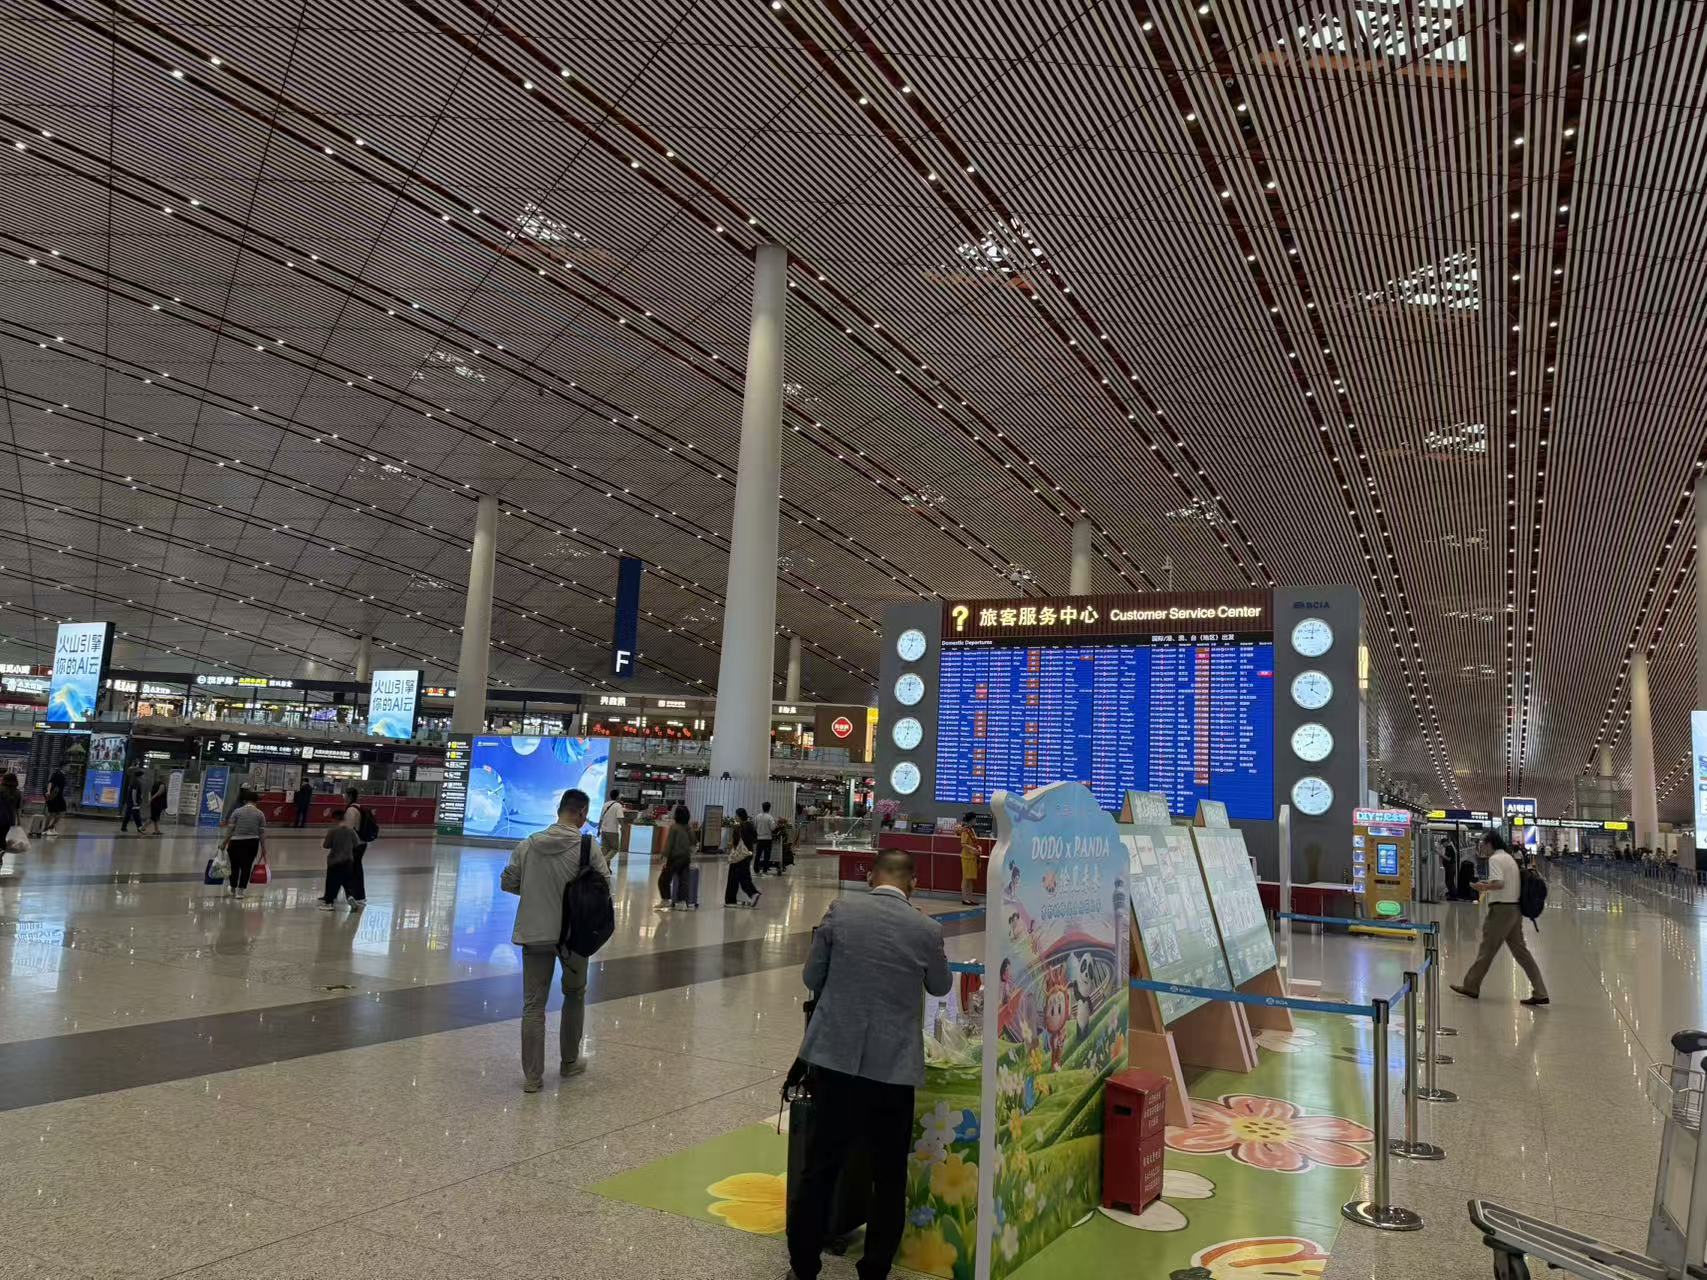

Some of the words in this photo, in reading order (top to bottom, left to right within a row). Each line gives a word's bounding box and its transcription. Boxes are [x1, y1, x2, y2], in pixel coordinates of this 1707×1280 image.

[979, 605, 1099, 627] 旅客服务中心
[1110, 608, 1168, 621] Customer
[1169, 606, 1216, 620] Service
[1217, 605, 1261, 618] Center
[58, 634, 102, 653] 火山引擎
[56, 656, 99, 675] 你的AI云
[615, 650, 631, 673] F
[373, 679, 415, 695] 火山引擎
[372, 697, 414, 712] 你的AI云
[206, 740, 216, 751] F
[221, 743, 234, 752] 35
[1031, 835, 1063, 860] DODO
[1073, 834, 1110, 857] PANDA
